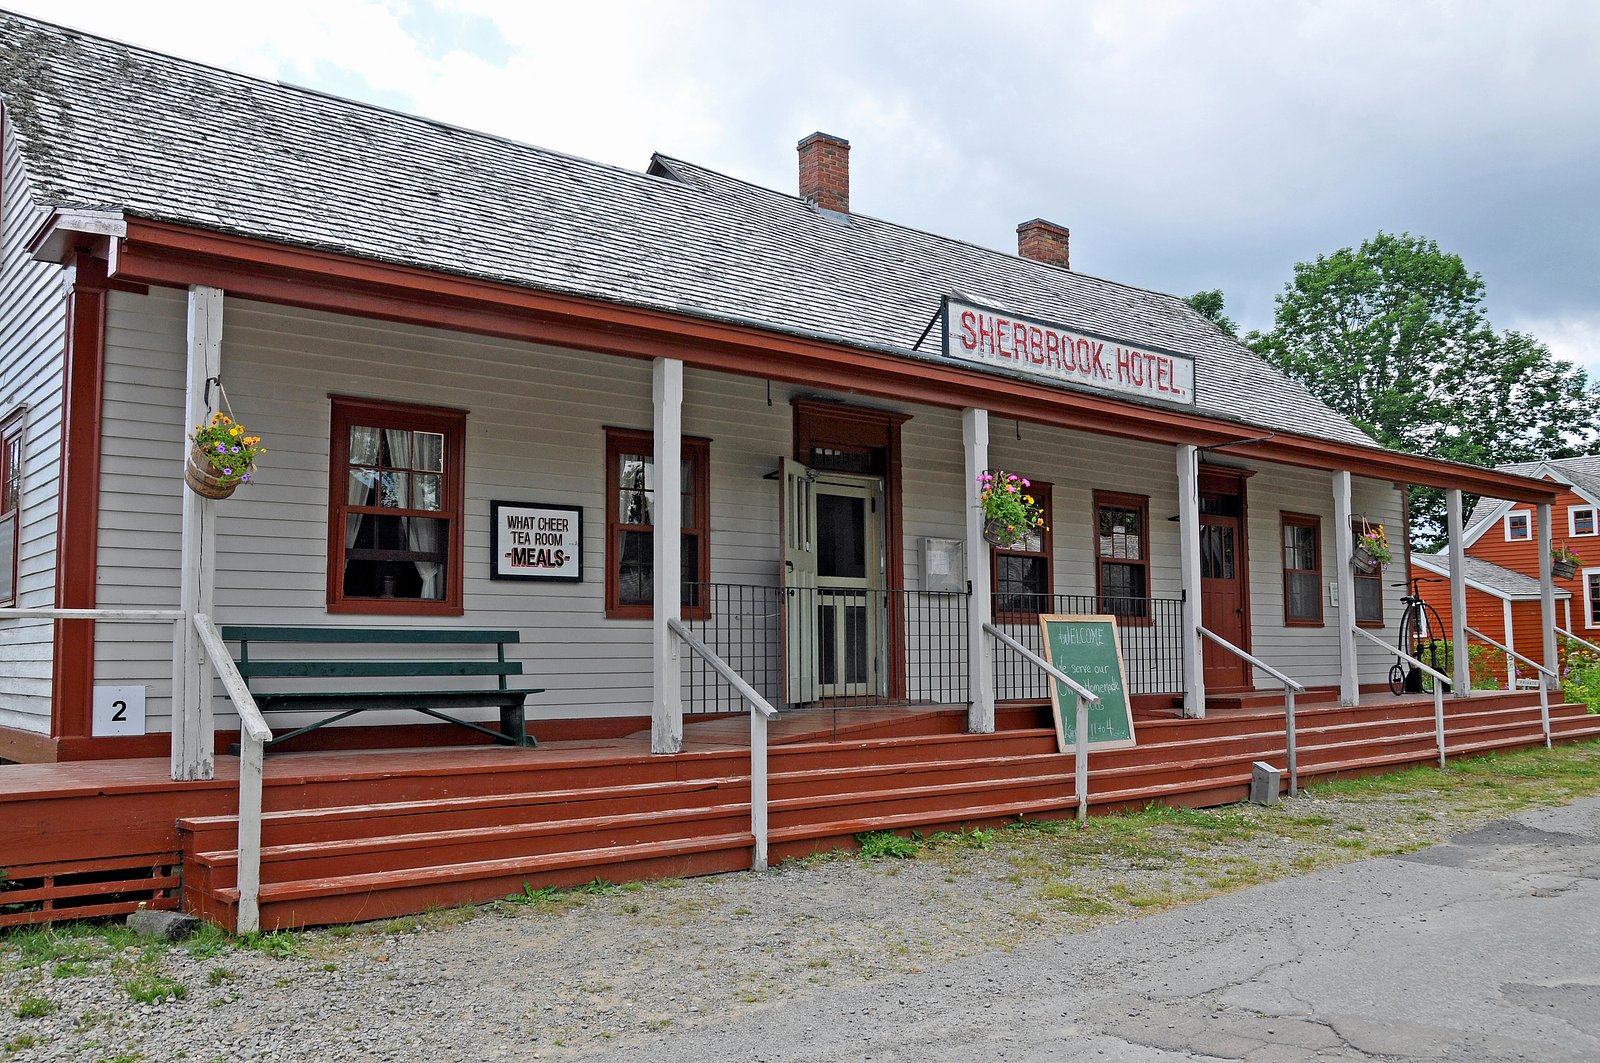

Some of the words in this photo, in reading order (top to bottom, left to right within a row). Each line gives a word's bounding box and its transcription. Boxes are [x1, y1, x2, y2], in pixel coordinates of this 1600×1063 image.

[961, 310, 1113, 380] SHERBROOKE
[507, 515, 535, 530] WHAT
[538, 517, 569, 532] CHEER
[510, 531, 531, 545] TEA
[534, 532, 563, 546] ROOM
[1059, 626, 1104, 646] WELCOME
[1056, 654, 1068, 674] We
[1070, 663, 1092, 674] serve
[1094, 665, 1110, 674] our
[111, 700, 127, 722] 2
[1106, 717, 1114, 737] 4
